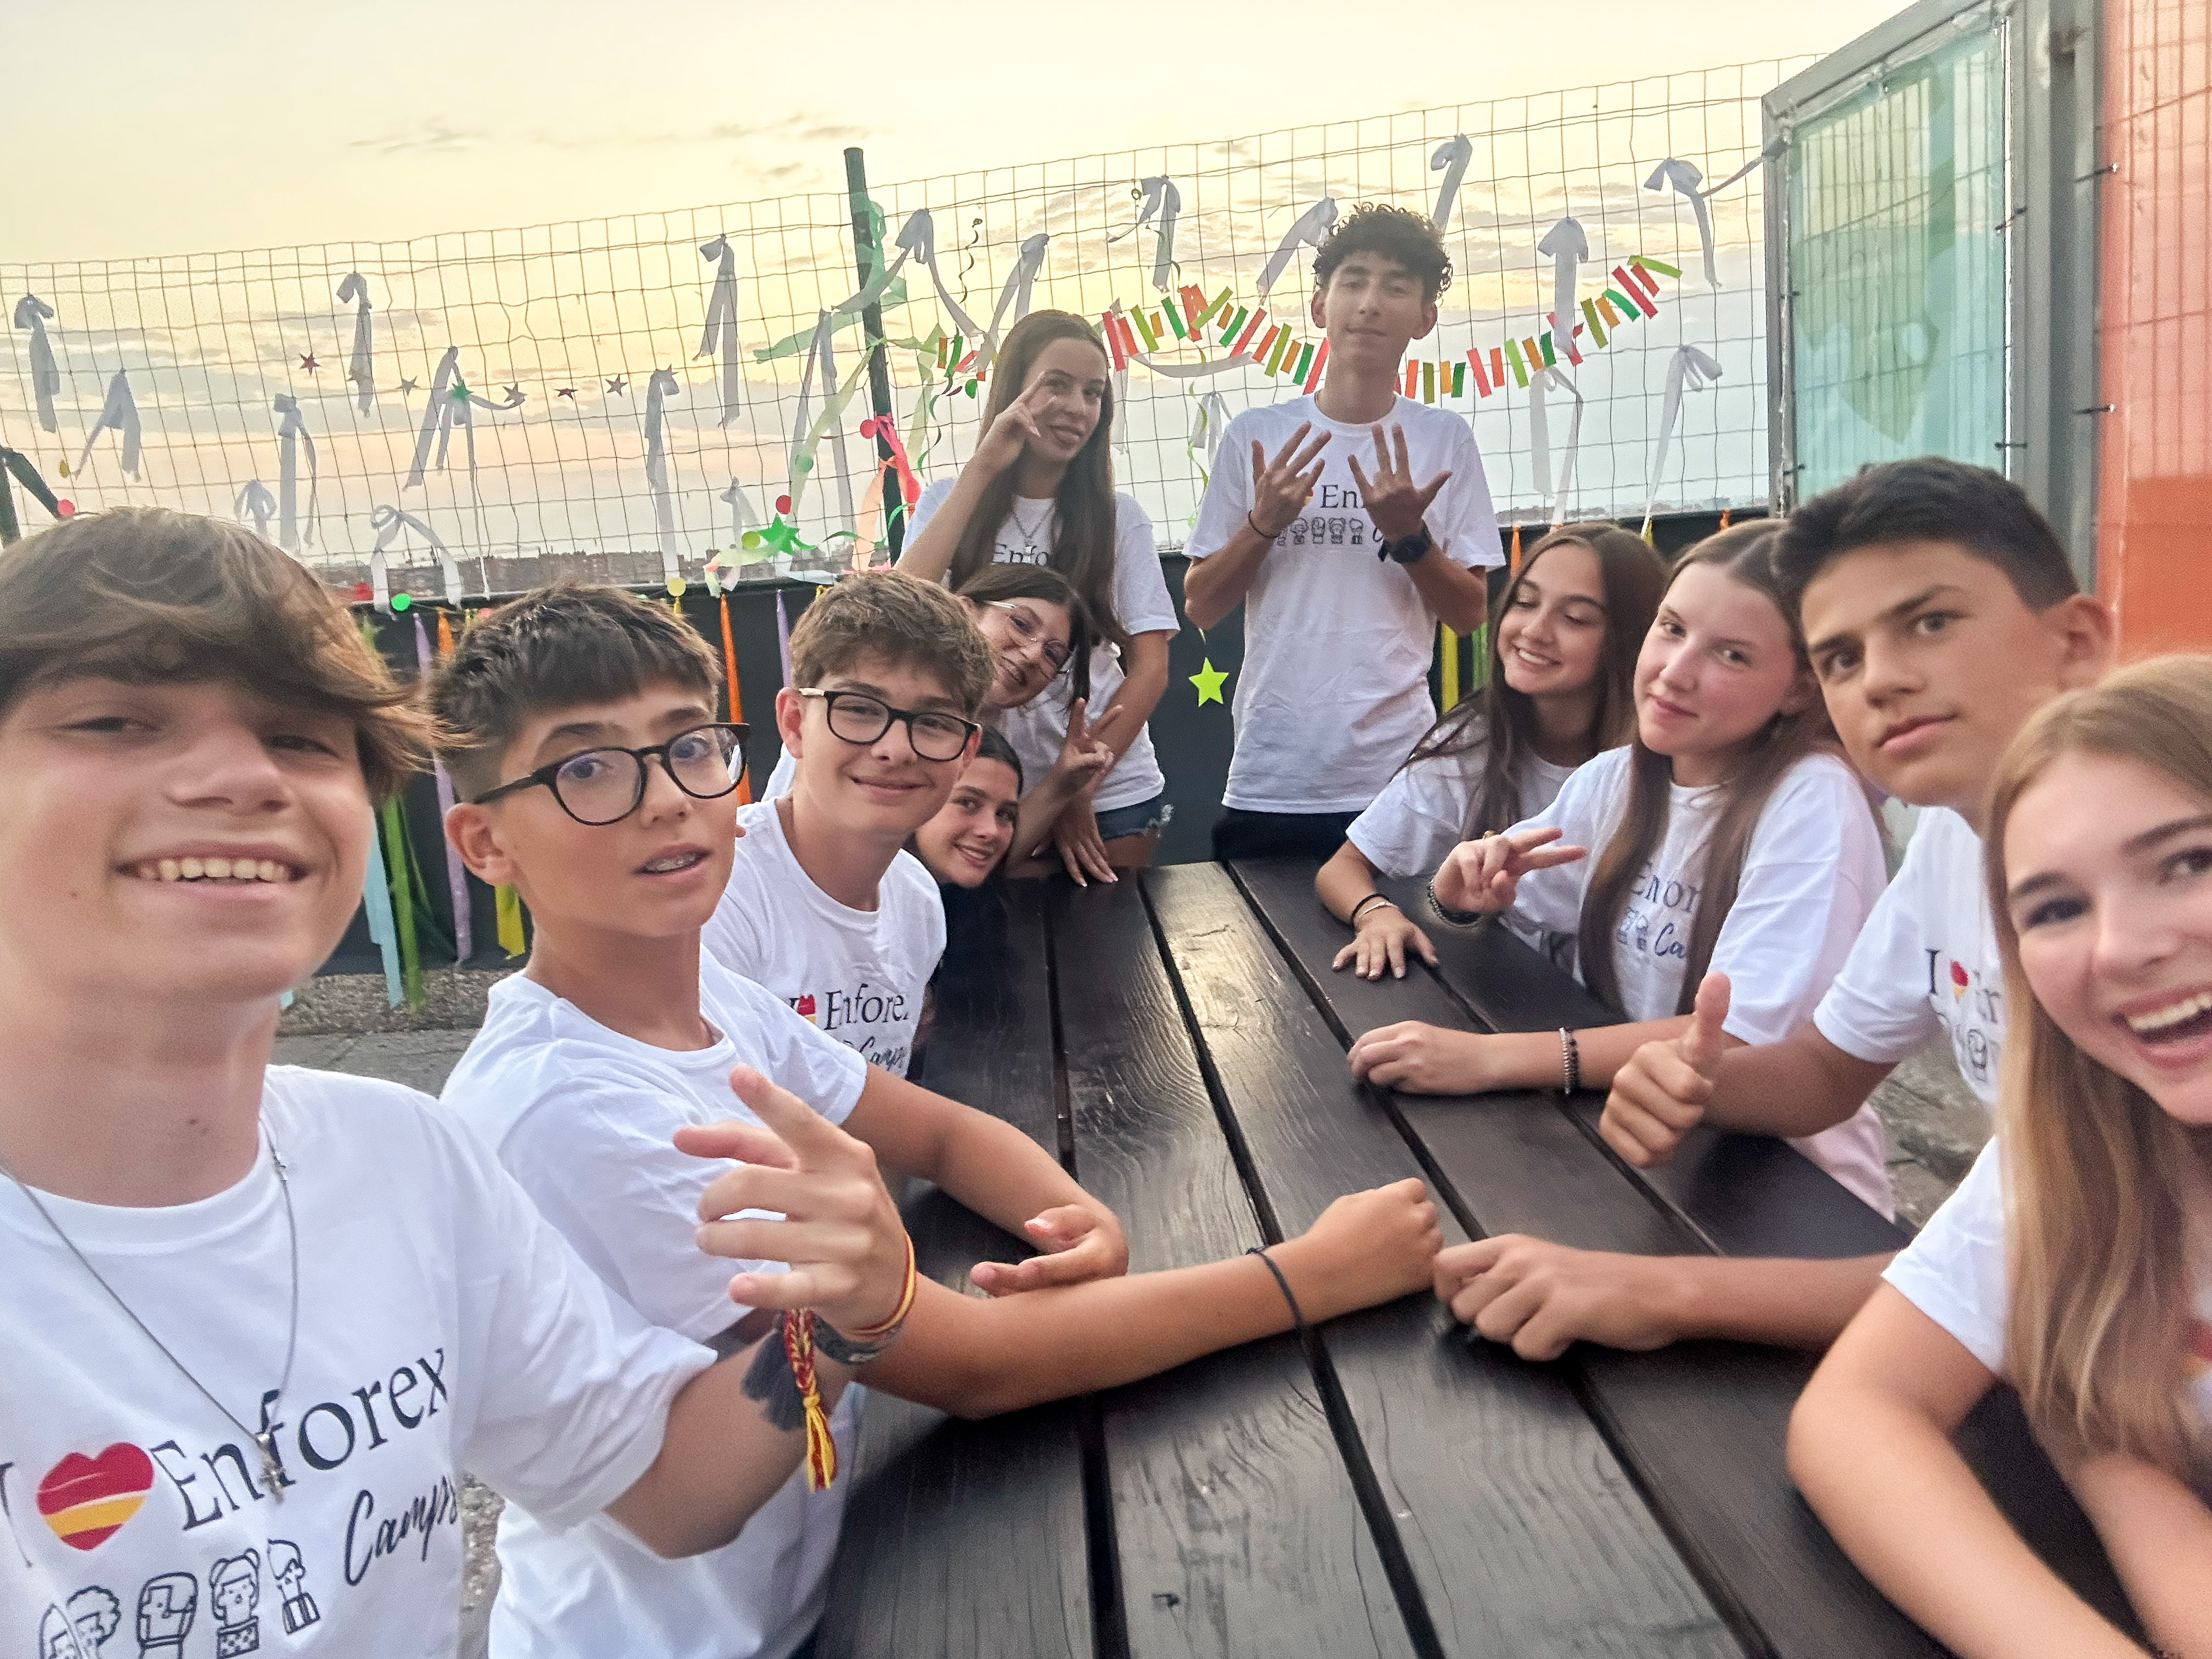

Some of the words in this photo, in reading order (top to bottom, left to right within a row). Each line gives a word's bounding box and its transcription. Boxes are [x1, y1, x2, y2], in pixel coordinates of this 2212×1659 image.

[1320, 484, 1365, 508] En
[824, 983, 909, 1030] Enfore
[150, 1348, 448, 1530] Enforex
